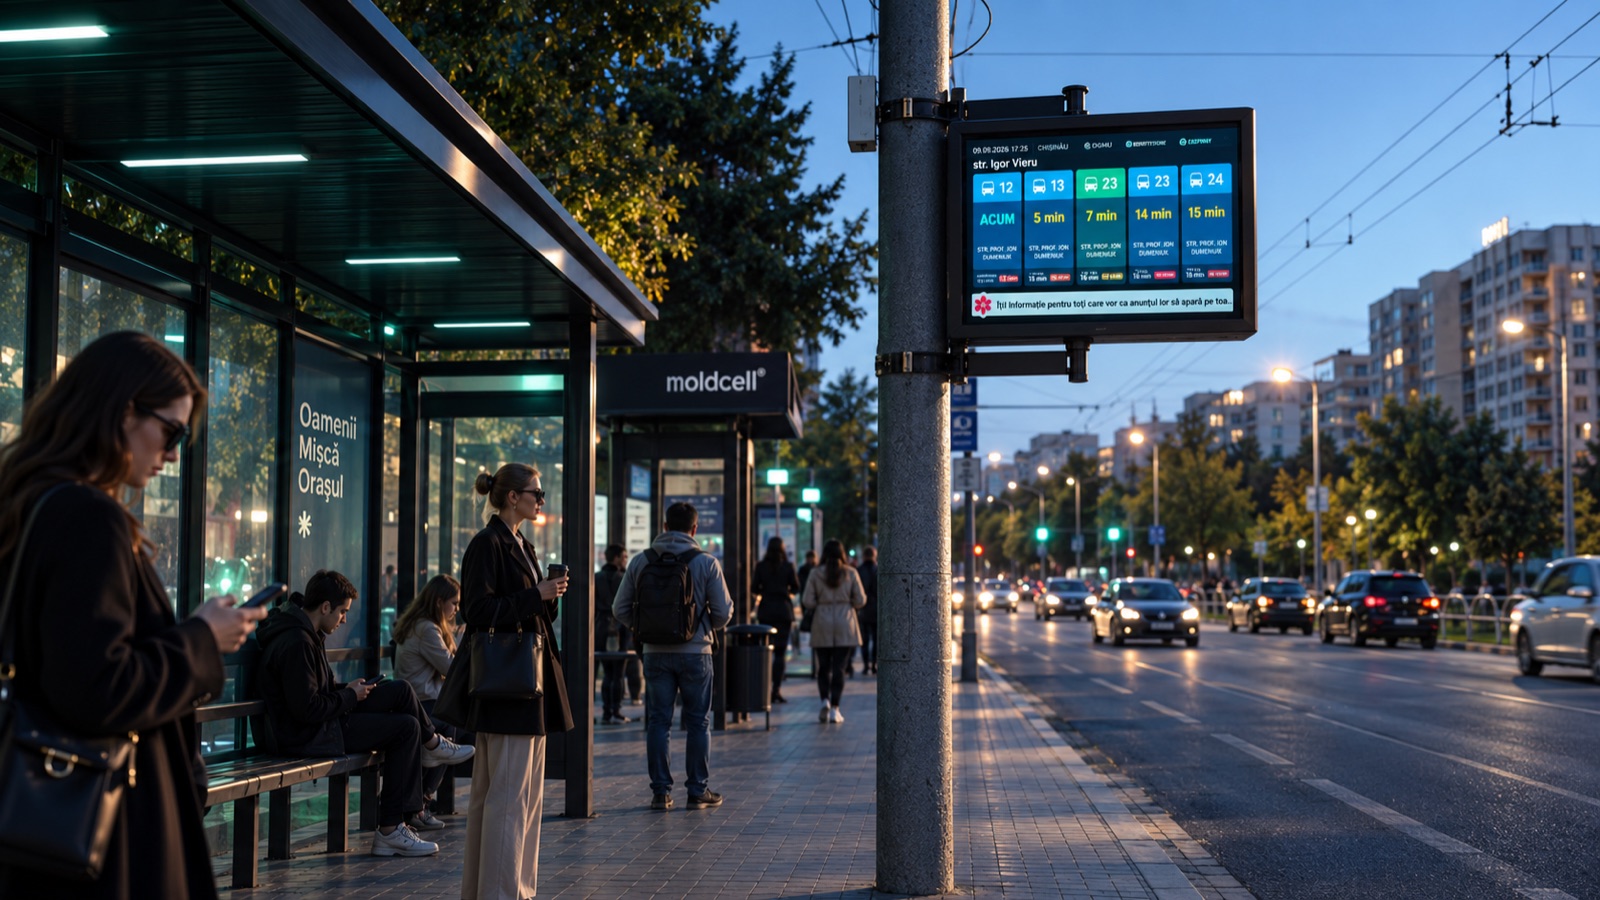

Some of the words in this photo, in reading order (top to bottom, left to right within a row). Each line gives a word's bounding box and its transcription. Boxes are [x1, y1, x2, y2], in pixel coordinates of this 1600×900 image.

[973, 160, 988, 169] str.
[991, 159, 1010, 171] Igor
[1012, 158, 1037, 167] Vieru
[1050, 179, 1064, 192] 13
[1102, 177, 1118, 190] 23
[1154, 175, 1170, 188] 23
[1208, 173, 1224, 186] 24
[999, 181, 1013, 194] 12
[1033, 212, 1041, 223] 5
[1044, 212, 1065, 223] min
[1085, 210, 1093, 222] 7
[1096, 210, 1117, 221] min
[1135, 208, 1148, 220] 14
[1151, 208, 1172, 220] min
[1188, 206, 1201, 218] 15
[1203, 206, 1225, 218] min
[980, 213, 1015, 226] ACUM
[1048, 301, 1072, 310] pentru
[1159, 298, 1169, 306] lor
[1204, 298, 1213, 307] pe
[299, 401, 357, 440] Oamenii
[299, 434, 340, 469] Mișcă
